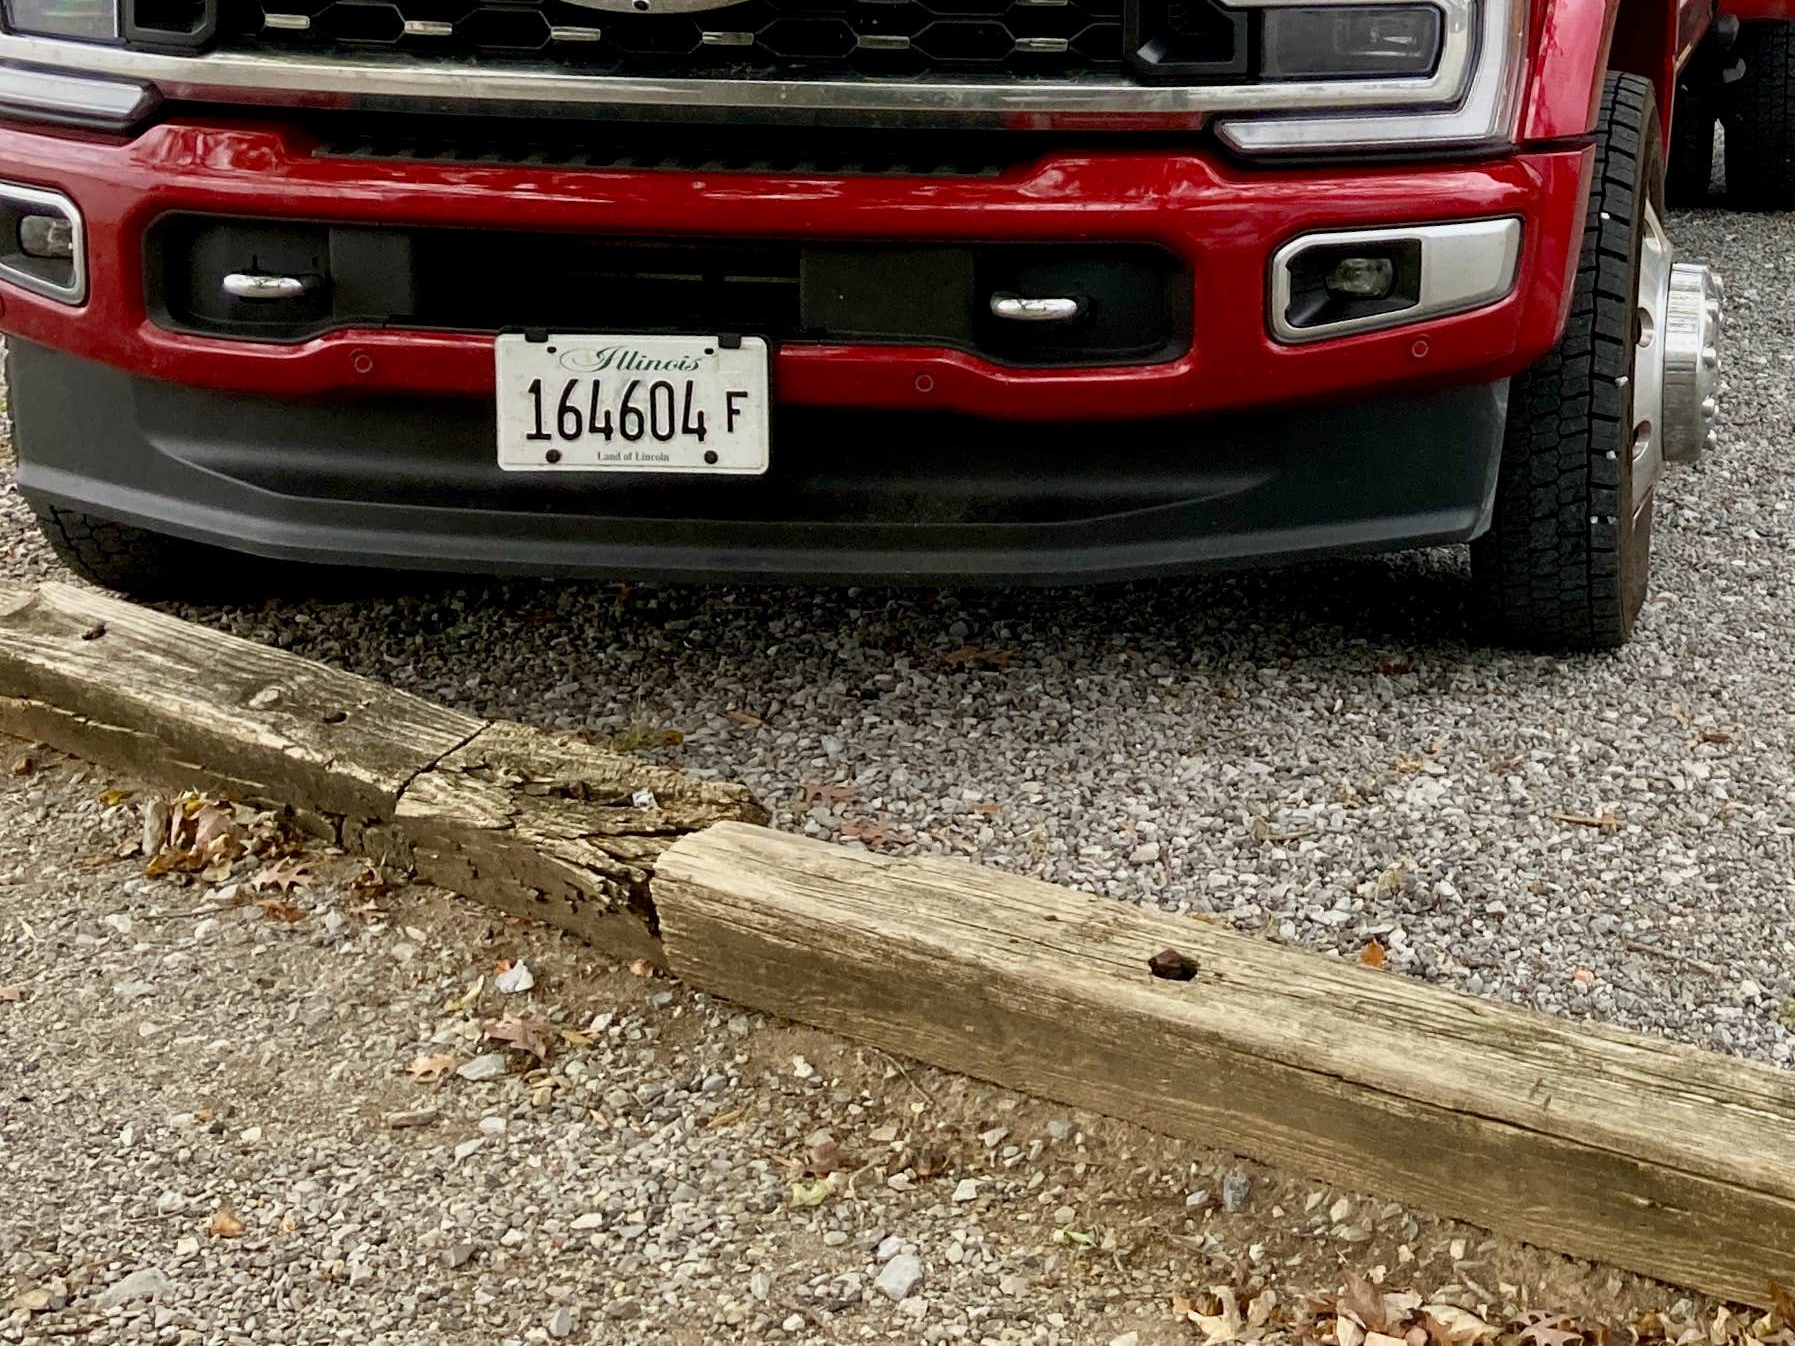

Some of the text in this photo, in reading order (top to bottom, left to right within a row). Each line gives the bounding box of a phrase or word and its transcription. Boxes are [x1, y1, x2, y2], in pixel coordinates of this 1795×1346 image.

[559, 345, 702, 373] Illinois
[526, 378, 749, 442] 164604 F
[597, 451, 621, 461] Land
[635, 451, 670, 462] Lincoln
